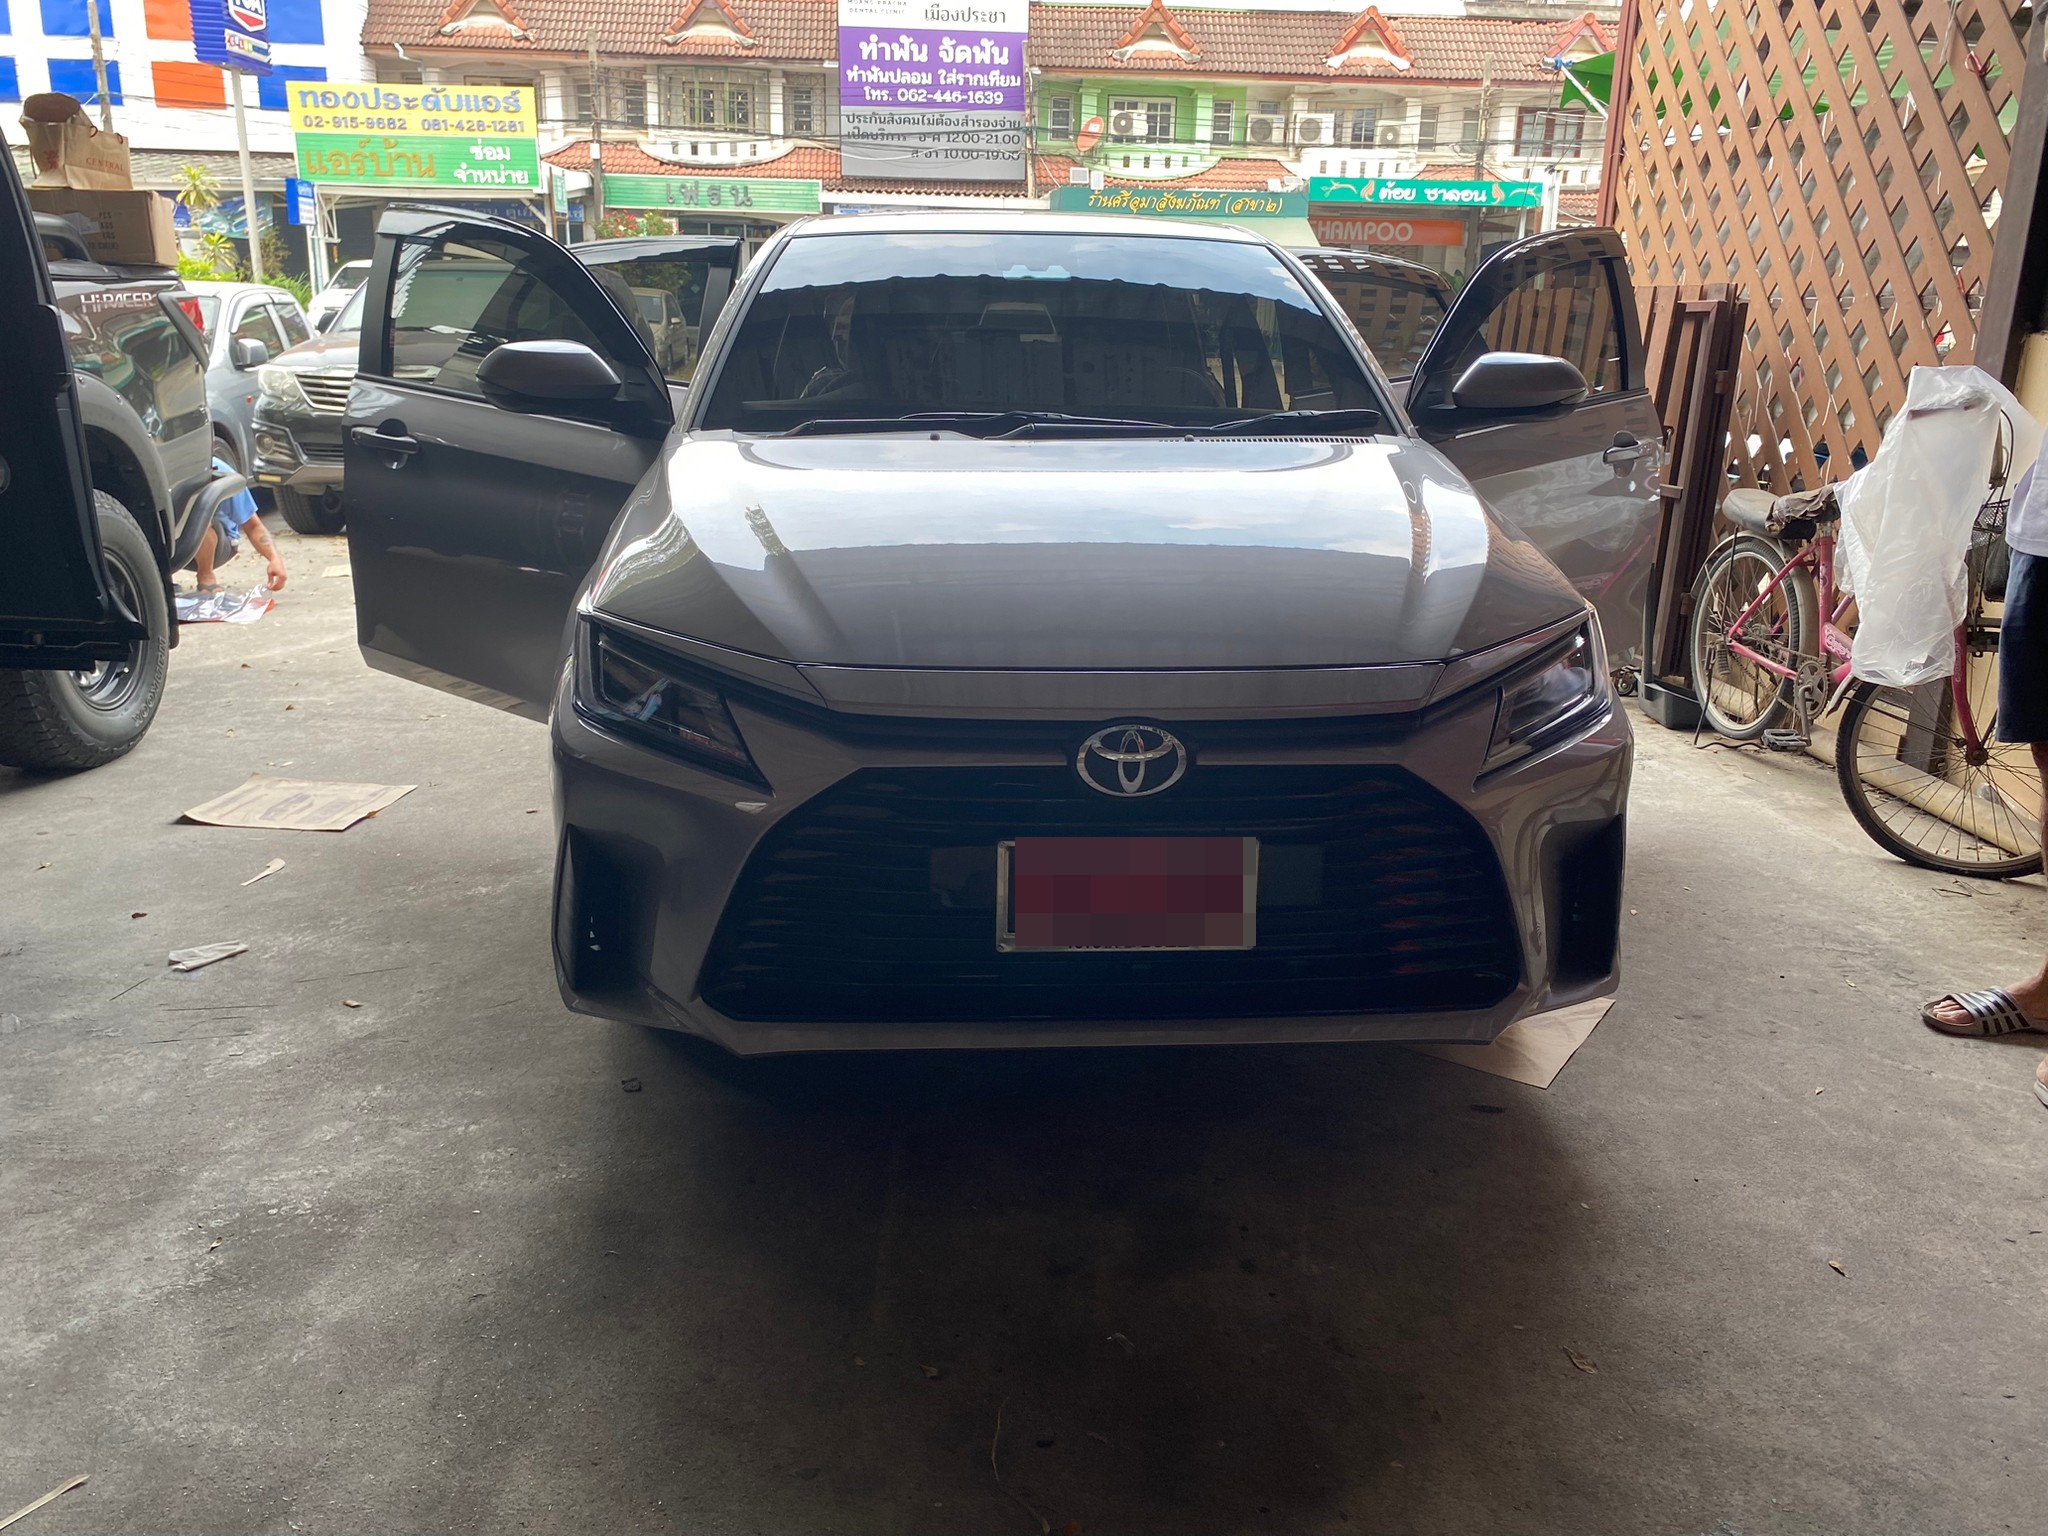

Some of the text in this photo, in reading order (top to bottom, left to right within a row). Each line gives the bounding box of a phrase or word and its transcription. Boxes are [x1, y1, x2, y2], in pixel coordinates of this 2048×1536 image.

[924, 3, 1006, 23] เมืองประชา
[858, 33, 1010, 66] ทำฟัน จัดฟัน
[845, 64, 1021, 88] ทำฟันปลอม ใส่รากเทียม
[297, 87, 522, 114] ทองประดับแอร์
[863, 86, 1004, 105] โทร. 062-446-1639
[845, 112, 1021, 130] ประกันสังคมไม่ต้องสำรองจ่าย
[469, 138, 511, 161] ซ่อม
[945, 132, 1021, 145] 12.00-21.00
[86, 157, 124, 171] CENTRAL
[304, 137, 436, 178] แอร์บ้าน
[453, 162, 529, 185] จำหน่าย
[1378, 181, 1487, 203] ต้อย ซาลอน
[1310, 221, 1413, 242] HAMPOO
